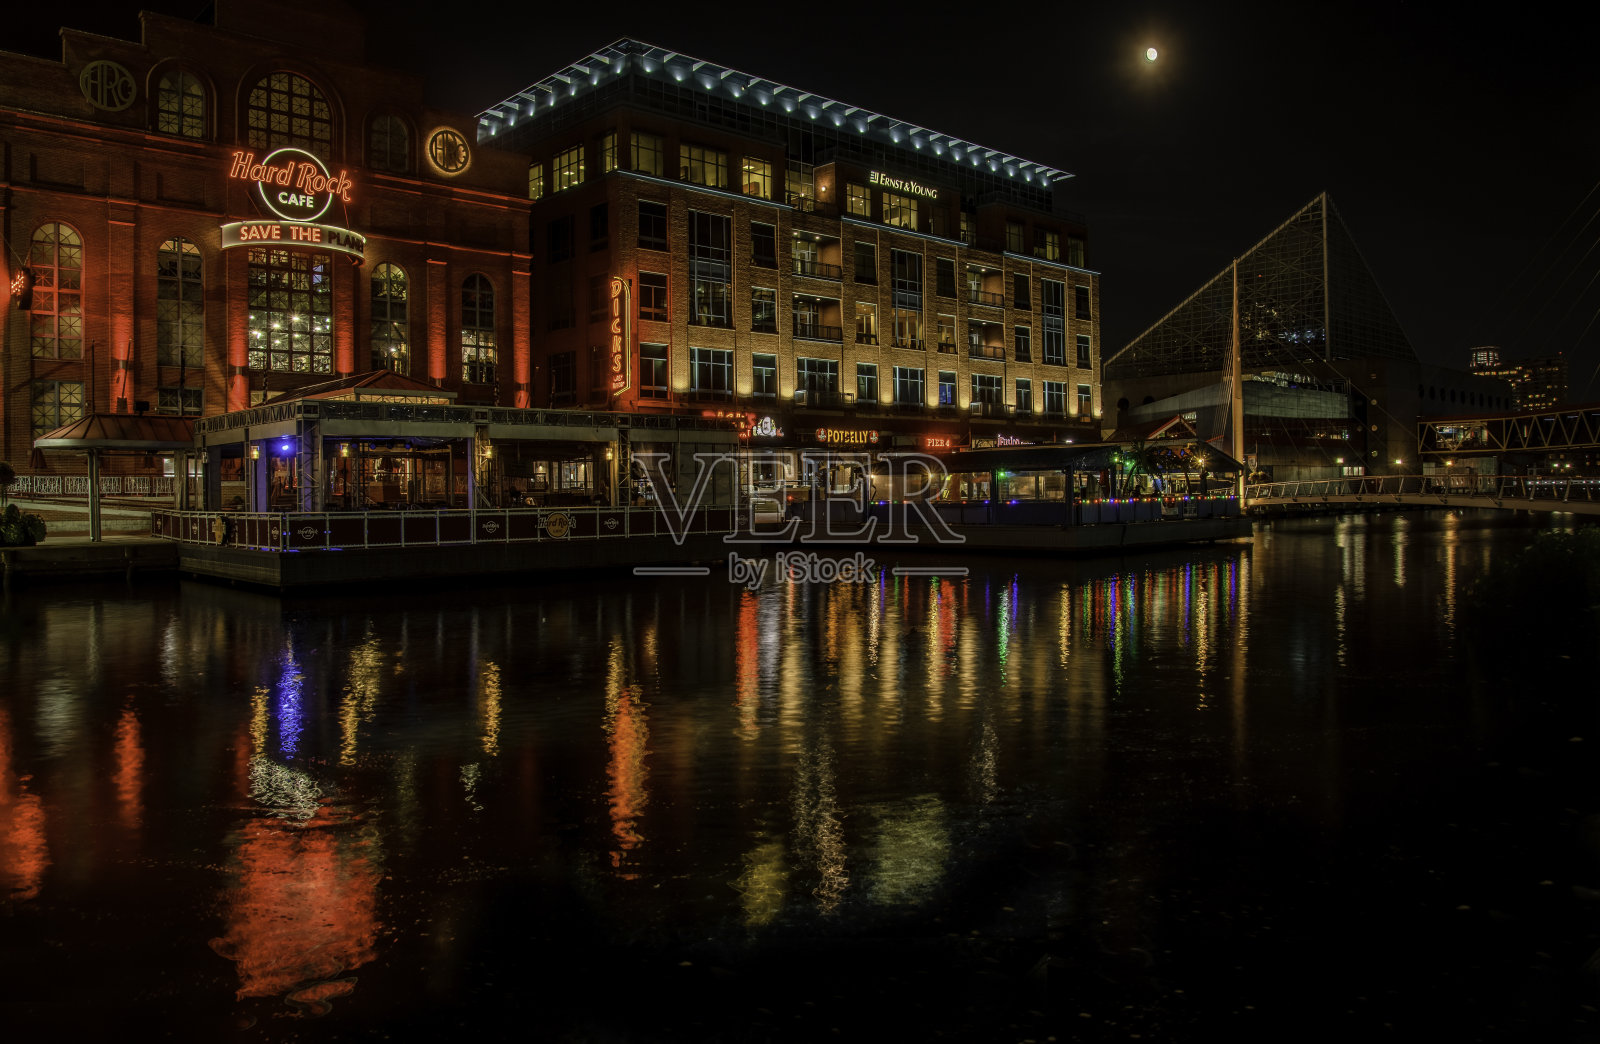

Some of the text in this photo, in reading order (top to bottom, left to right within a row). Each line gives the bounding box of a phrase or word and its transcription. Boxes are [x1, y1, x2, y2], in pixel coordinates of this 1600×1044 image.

[230, 151, 353, 202] Hard Rock
[278, 191, 315, 208] CAFE
[240, 225, 281, 241] SAVE
[290, 226, 321, 242] THE
[827, 429, 868, 443] POTBELLY
[927, 438, 945, 447] PIER
